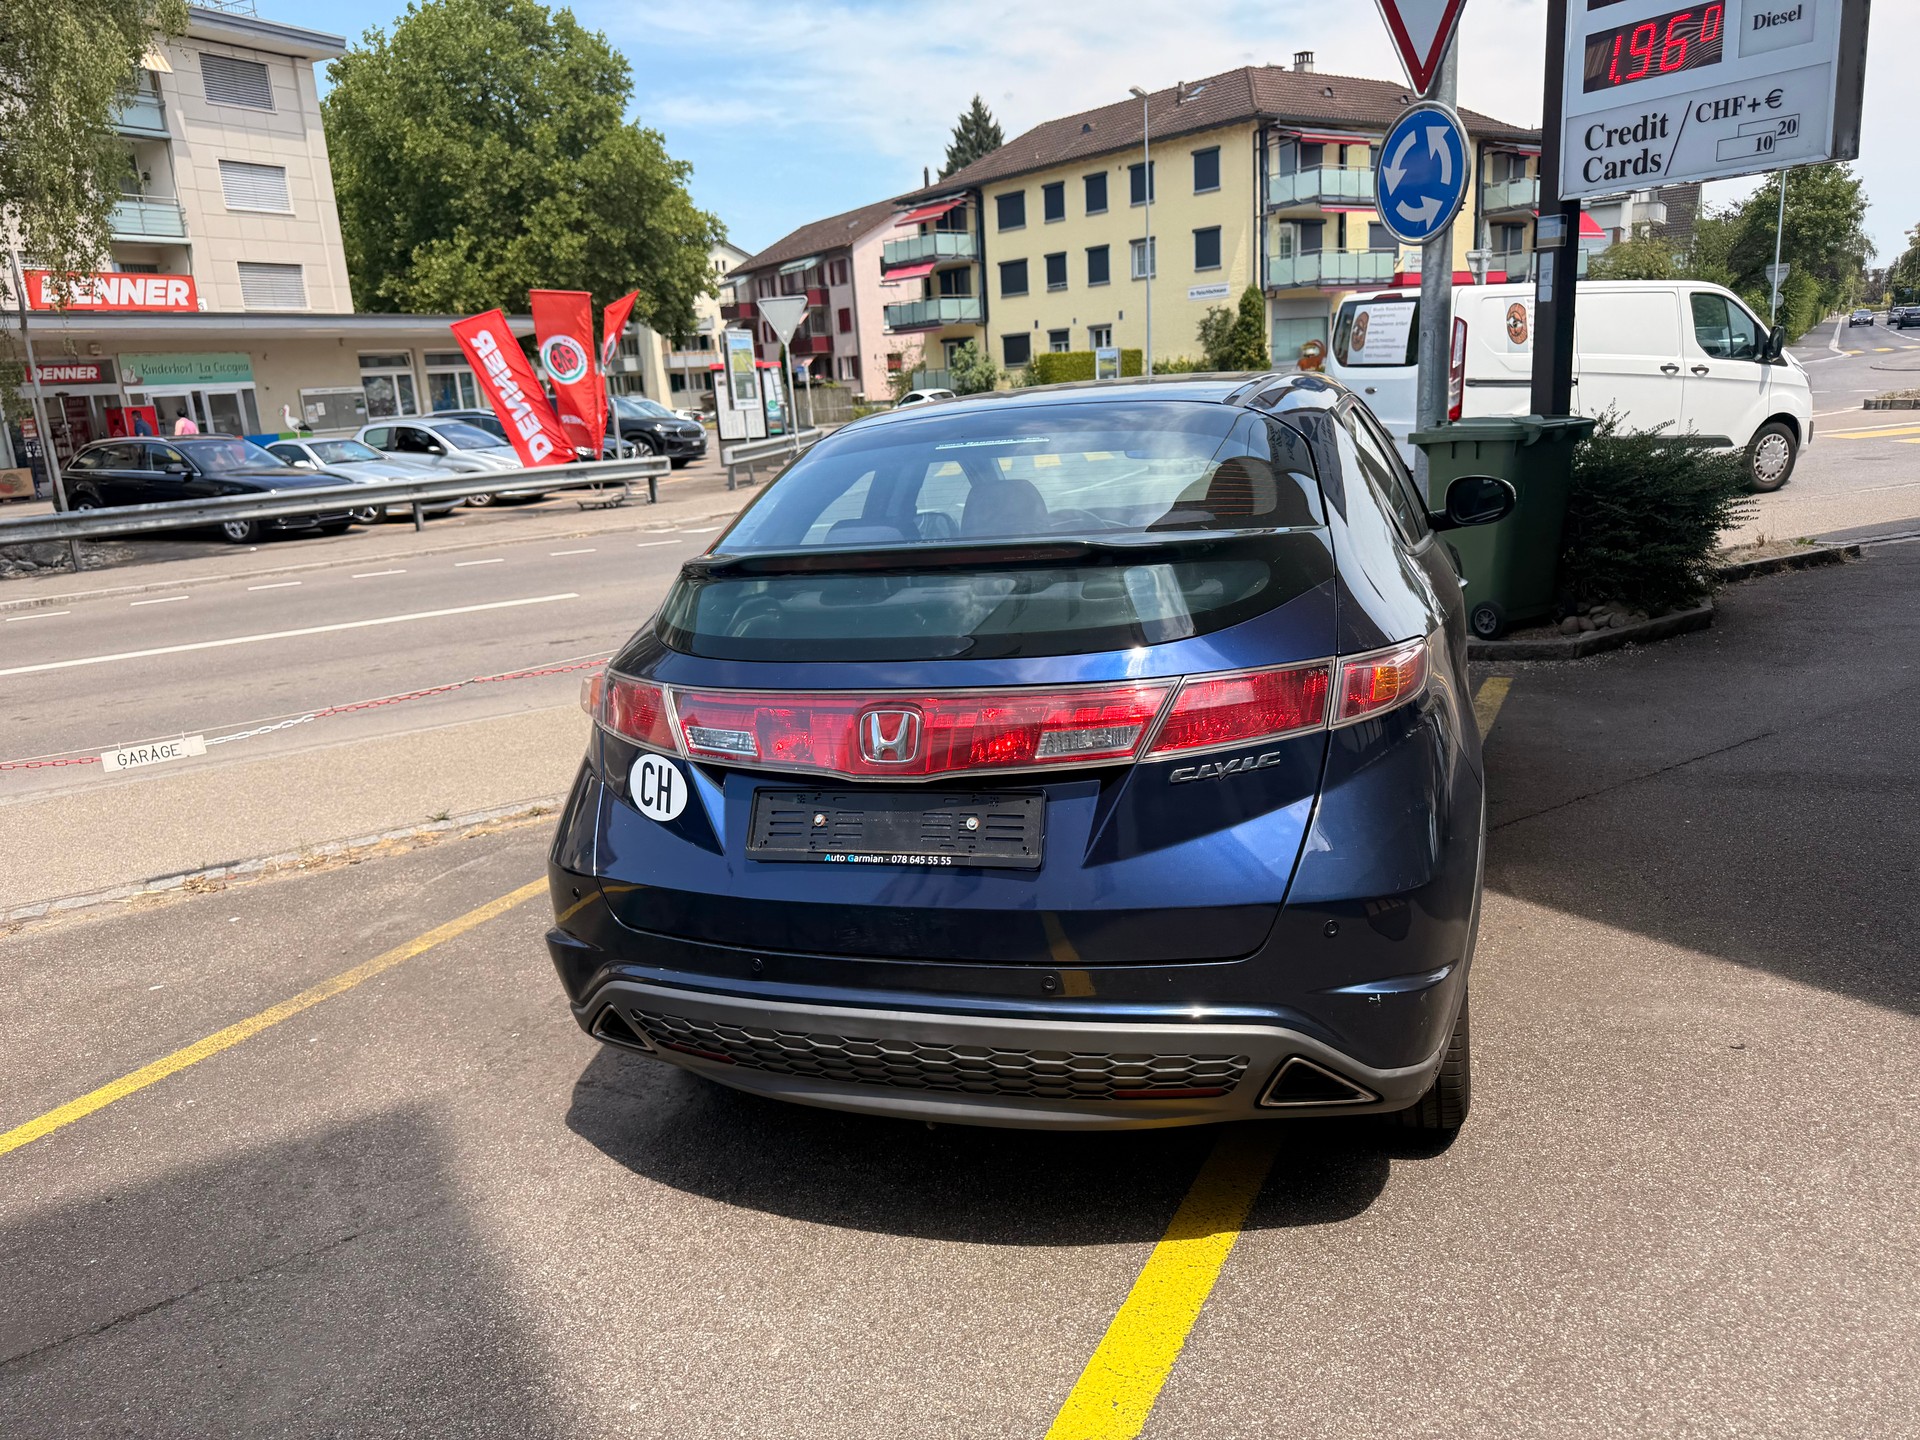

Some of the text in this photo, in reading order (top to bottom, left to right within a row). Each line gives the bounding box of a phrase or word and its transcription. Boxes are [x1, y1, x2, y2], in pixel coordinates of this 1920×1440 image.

[1752, 4, 1803, 31] Diesel
[1584, 112, 1669, 151] Credit
[1777, 118, 1797, 136] 20
[1755, 135, 1773, 152] 10
[1582, 148, 1662, 184] Cards
[117, 743, 181, 767] GARAGE
[1170, 751, 1280, 782] CIVIC
[641, 761, 673, 814] CH
[825, 854, 846, 862] Auto
[847, 854, 884, 863] Garmian
[891, 855, 908, 864] 078
[909, 855, 926, 864] 645
[927, 856, 939, 865] 55
[940, 856, 952, 866] 55
